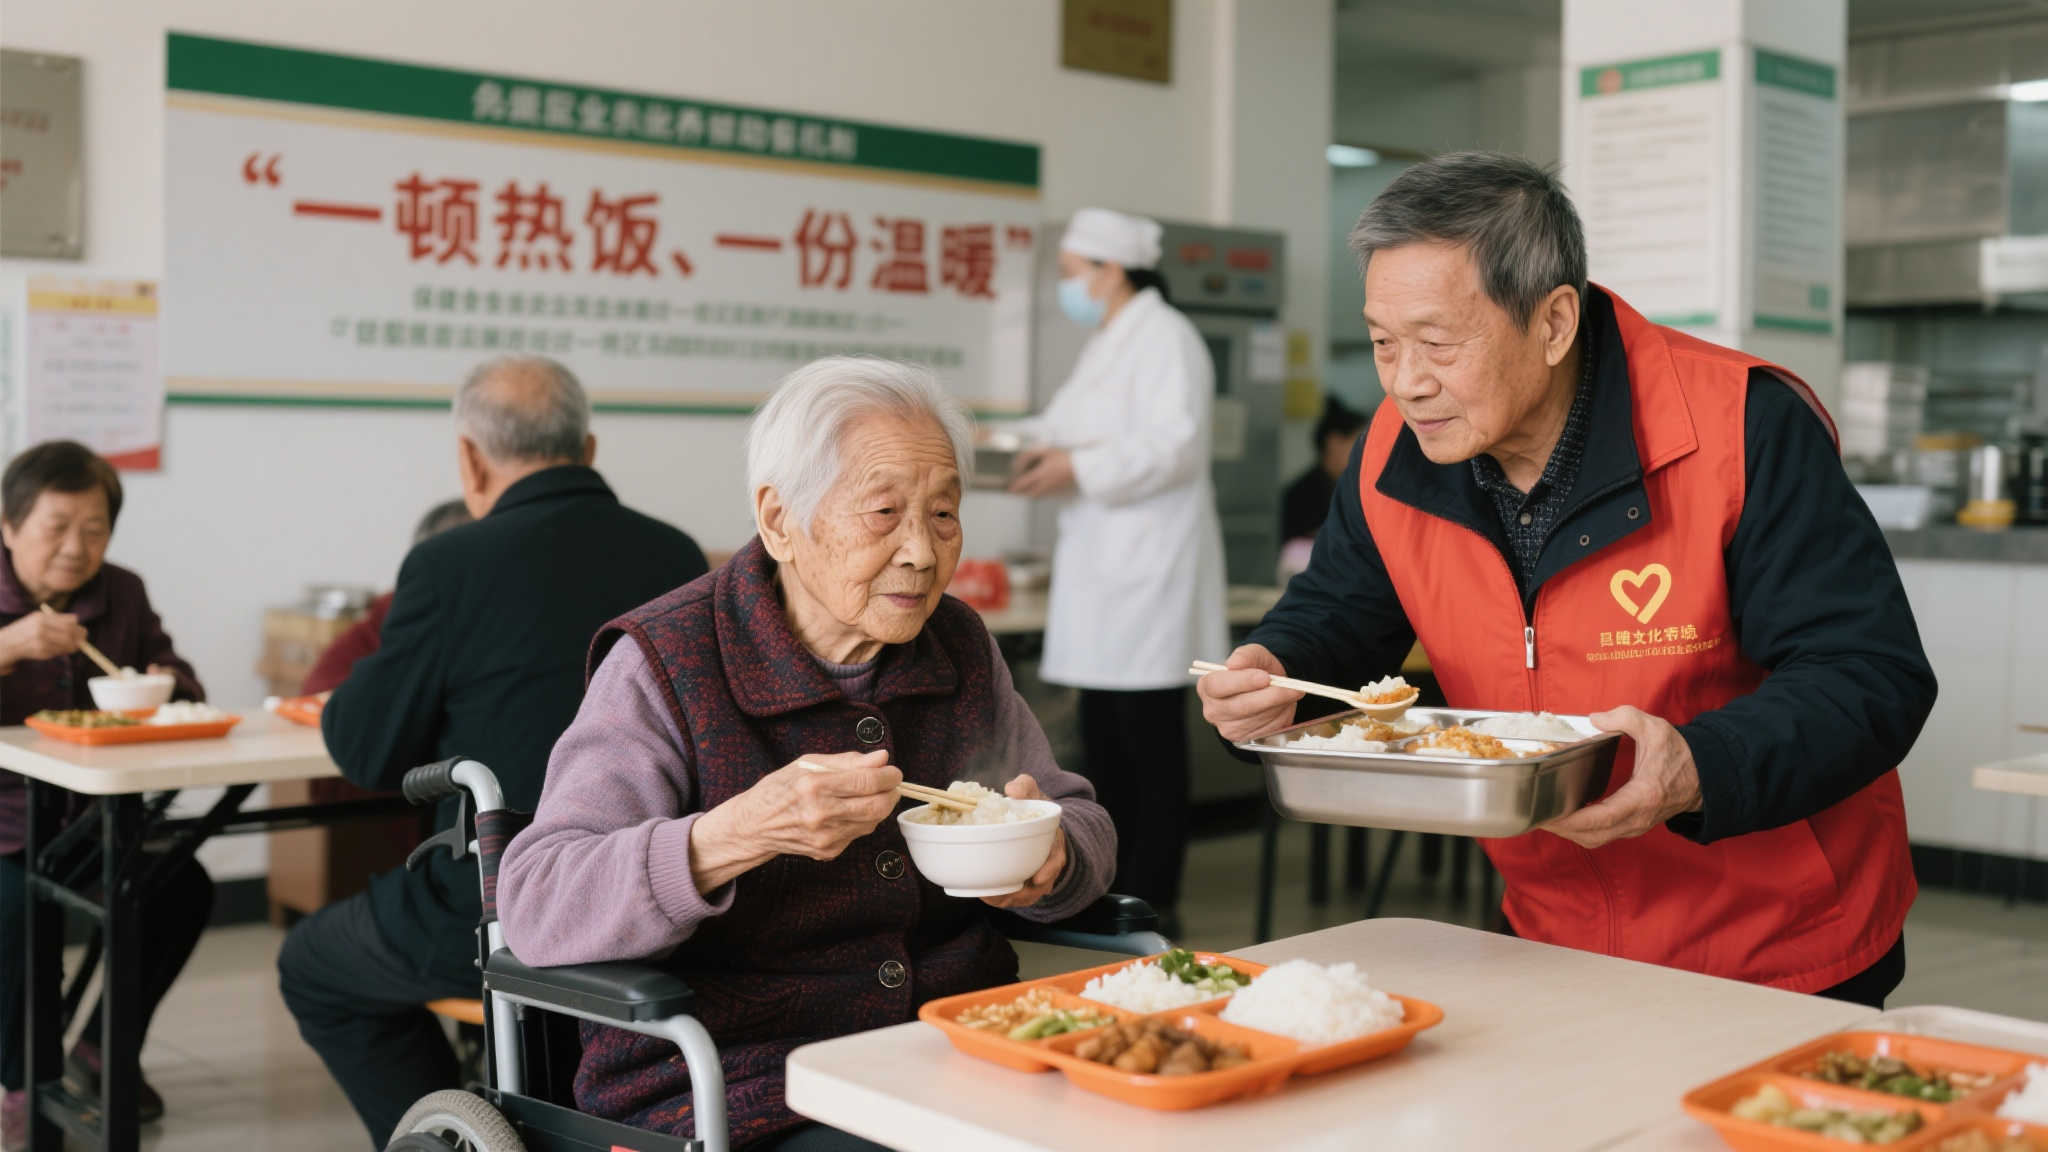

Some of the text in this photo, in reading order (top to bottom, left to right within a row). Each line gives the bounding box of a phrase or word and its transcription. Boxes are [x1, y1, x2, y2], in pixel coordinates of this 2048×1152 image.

[241, 152, 1032, 299] “一顿热饭、一份温暖”
